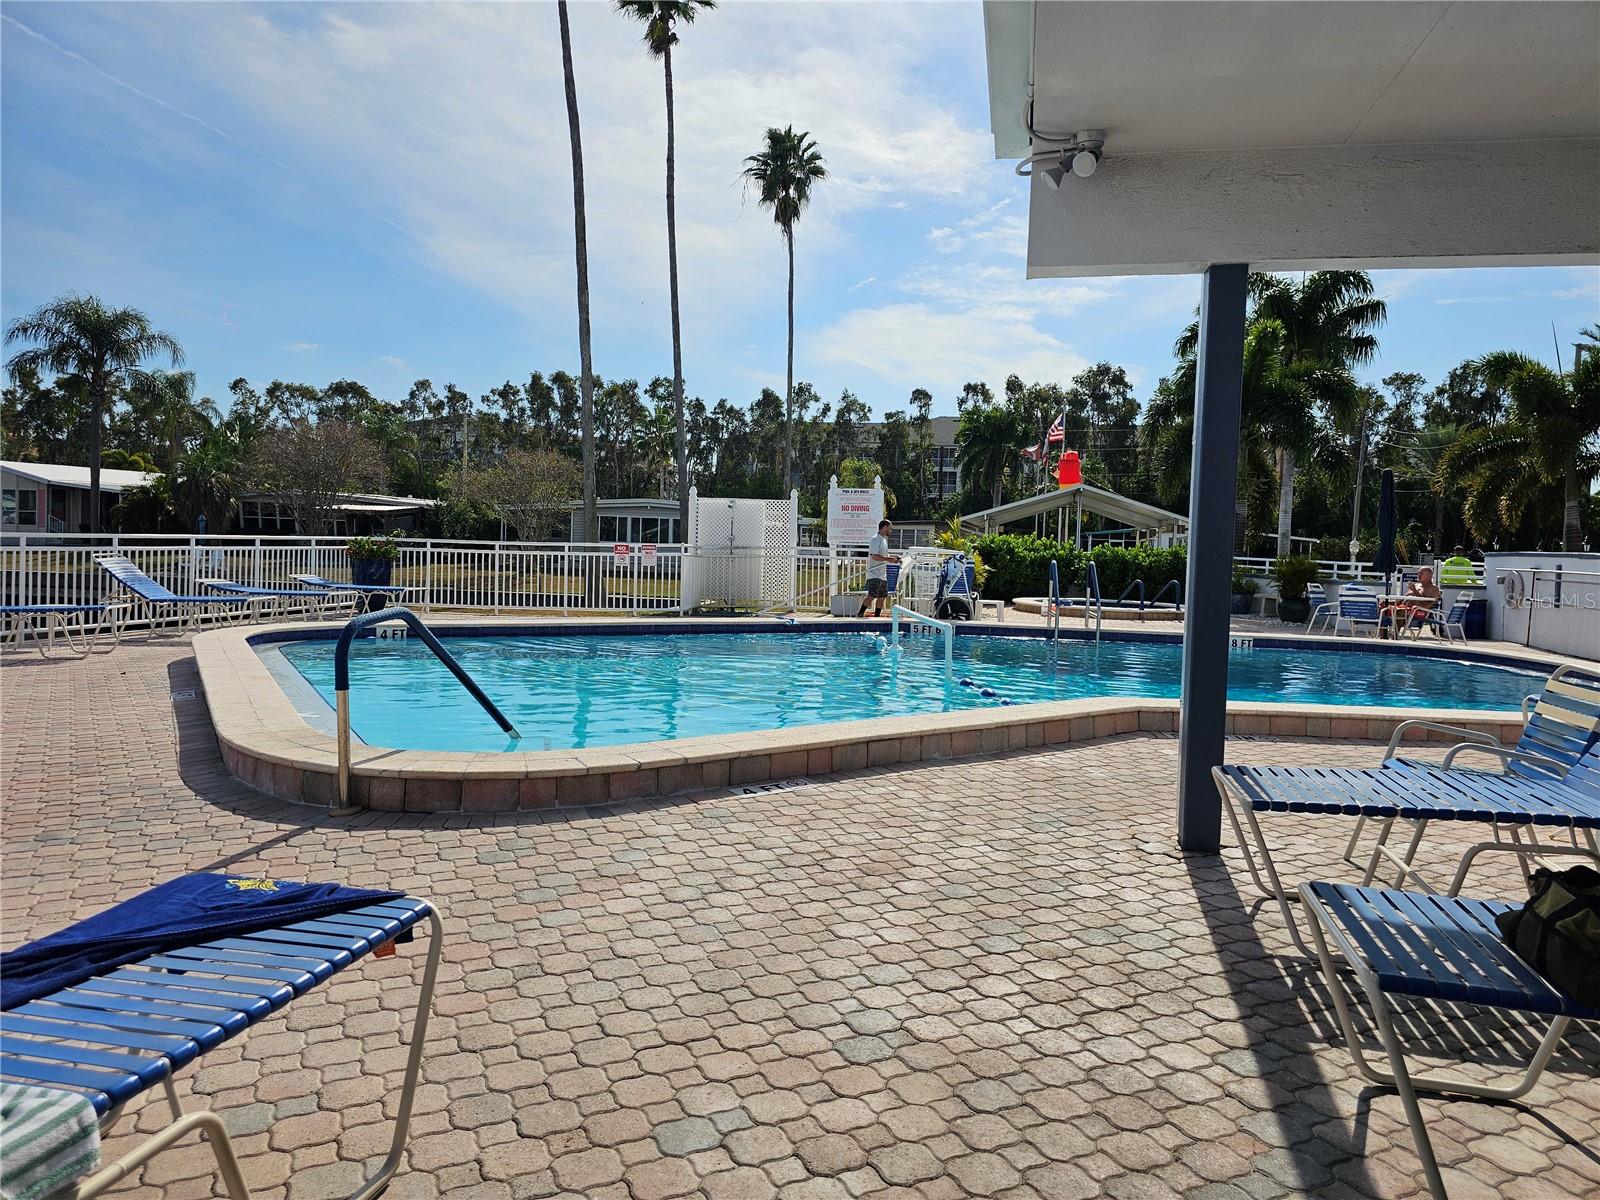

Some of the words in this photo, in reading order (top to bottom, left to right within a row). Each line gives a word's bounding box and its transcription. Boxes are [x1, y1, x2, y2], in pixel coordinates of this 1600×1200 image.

[380, 630, 388, 639] 4
[392, 629, 406, 639] FT
[914, 625, 918, 633] 5
[922, 626, 932, 634] FT
[1232, 639, 1238, 647] 8
[1241, 639, 1252, 647] FT
[760, 783, 784, 792] FT
